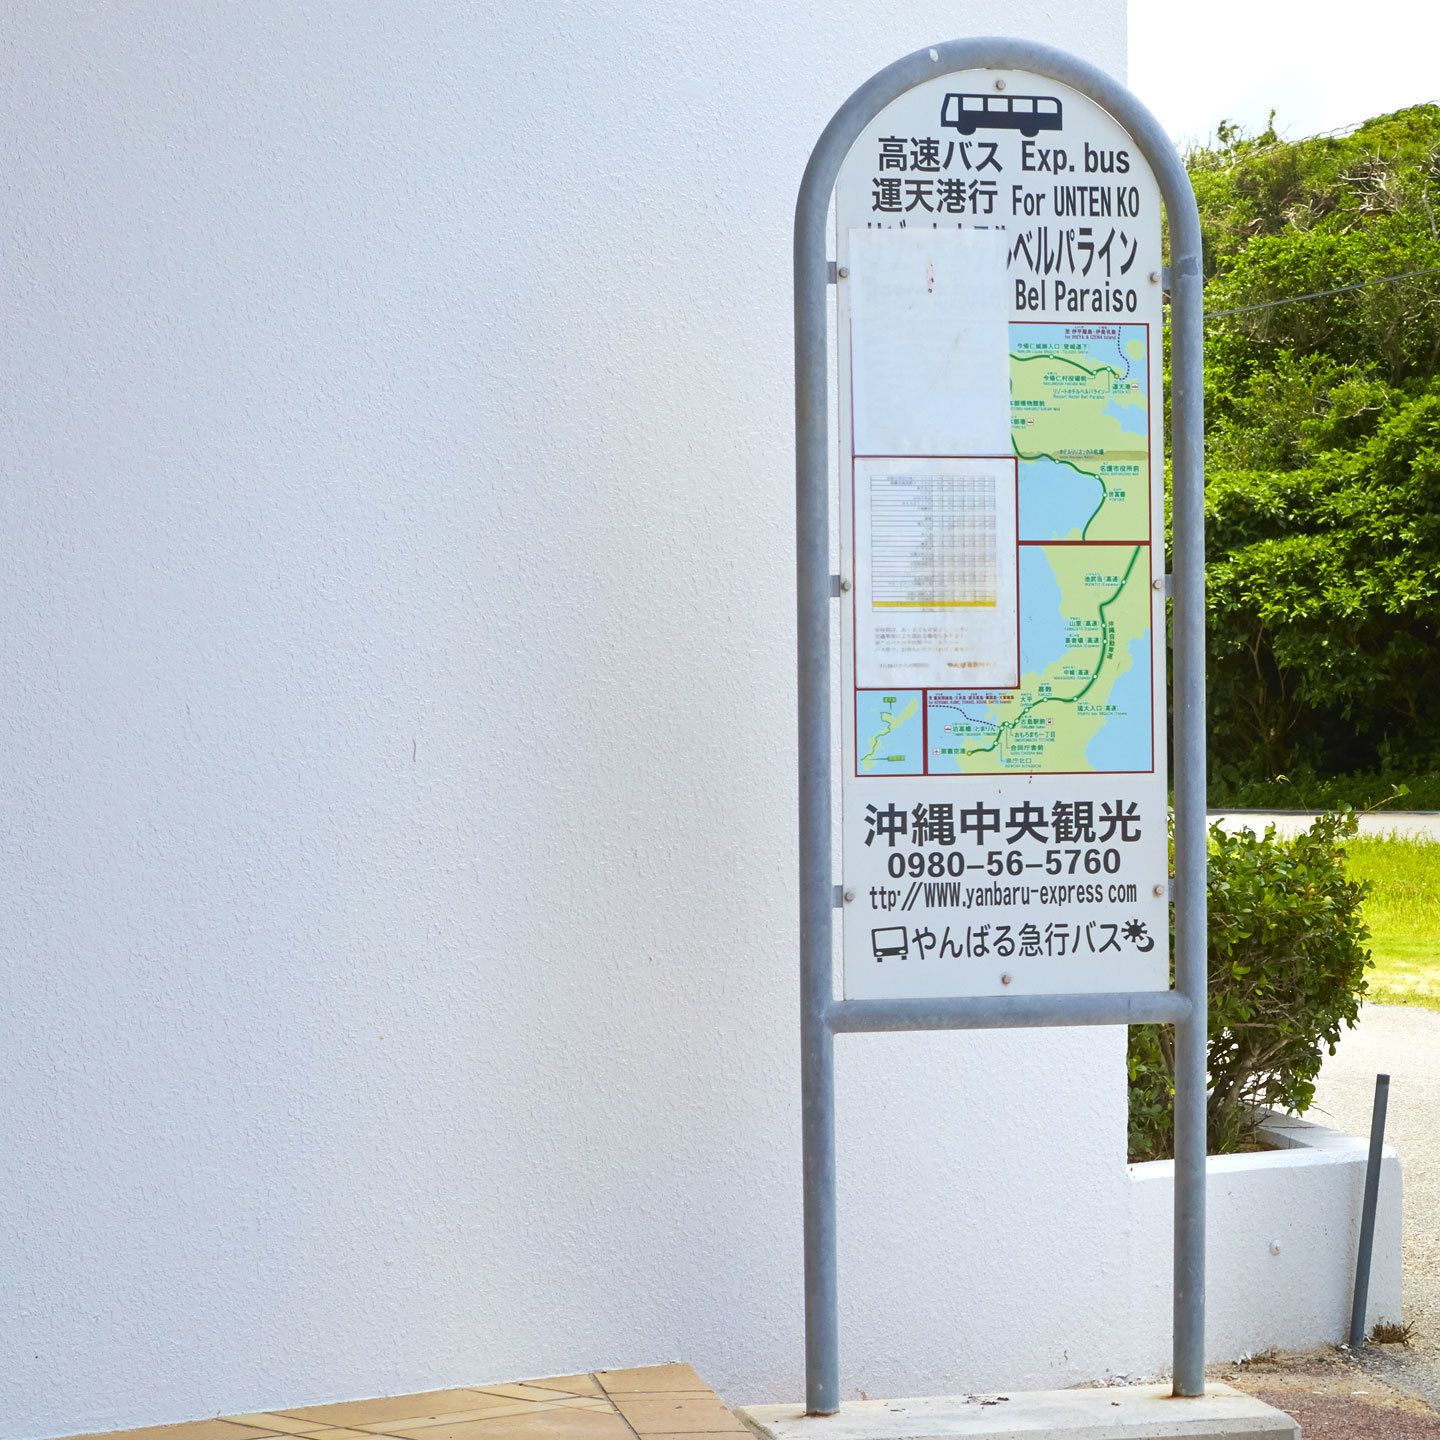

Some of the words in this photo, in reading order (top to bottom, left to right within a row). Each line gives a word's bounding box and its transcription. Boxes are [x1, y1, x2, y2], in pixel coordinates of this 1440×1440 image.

[878, 135, 1003, 173] 高速バス
[1021, 140, 1075, 175] Exp.
[1084, 141, 1130, 173] bus
[871, 178, 998, 214] 運天港行
[1012, 185, 1046, 216] For
[1054, 186, 1111, 217] UNTEN
[1116, 187, 1140, 217] KO
[1015, 279, 1046, 311] Bel
[1054, 279, 1138, 313] Paraiso
[864, 800, 1142, 847] 沖縄中央観光
[887, 848, 1121, 879] 0980-56-5760
[911, 920, 1122, 961] やんばる急行バス
